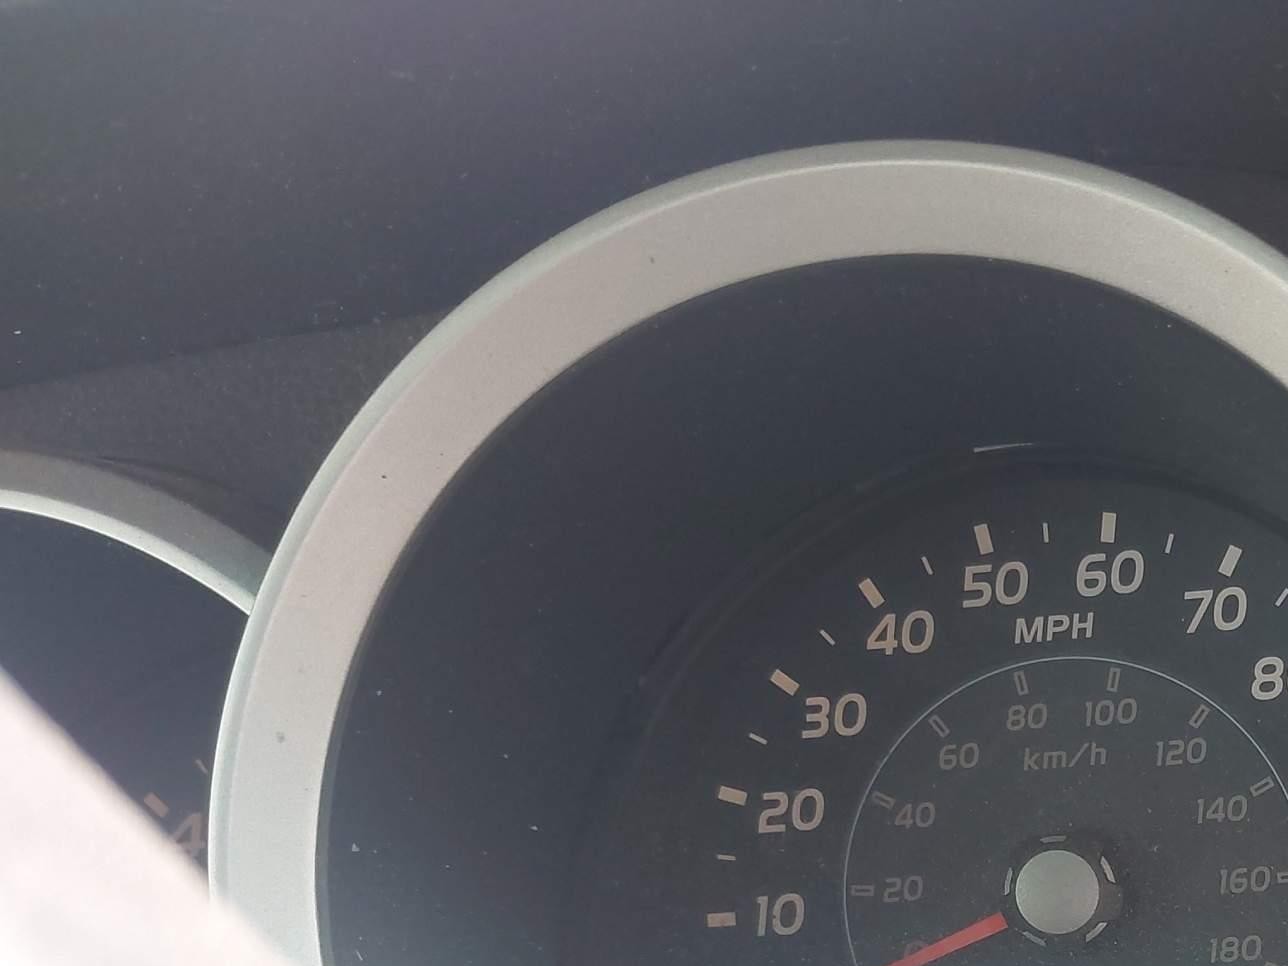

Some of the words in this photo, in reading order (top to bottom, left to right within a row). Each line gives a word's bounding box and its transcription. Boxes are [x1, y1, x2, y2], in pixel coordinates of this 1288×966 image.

[961, 561, 1029, 608] 50
[1076, 550, 1145, 596] 60
[1183, 586, 1248, 635] 70
[866, 609, 935, 655] 40
[1013, 612, 1094, 645] MPH
[801, 692, 868, 740] 30
[1007, 703, 1048, 731] 80
[1083, 699, 1138, 726] 100
[938, 742, 980, 770] 60
[1023, 742, 1108, 772] km/h
[1155, 738, 1208, 767] 120
[757, 789, 825, 833] 20
[894, 801, 936, 829] 40
[1197, 795, 1248, 824] 140
[882, 876, 924, 902] 20
[1219, 866, 1272, 893] 160
[756, 892, 805, 936] 10
[1208, 936, 1262, 963] 180
